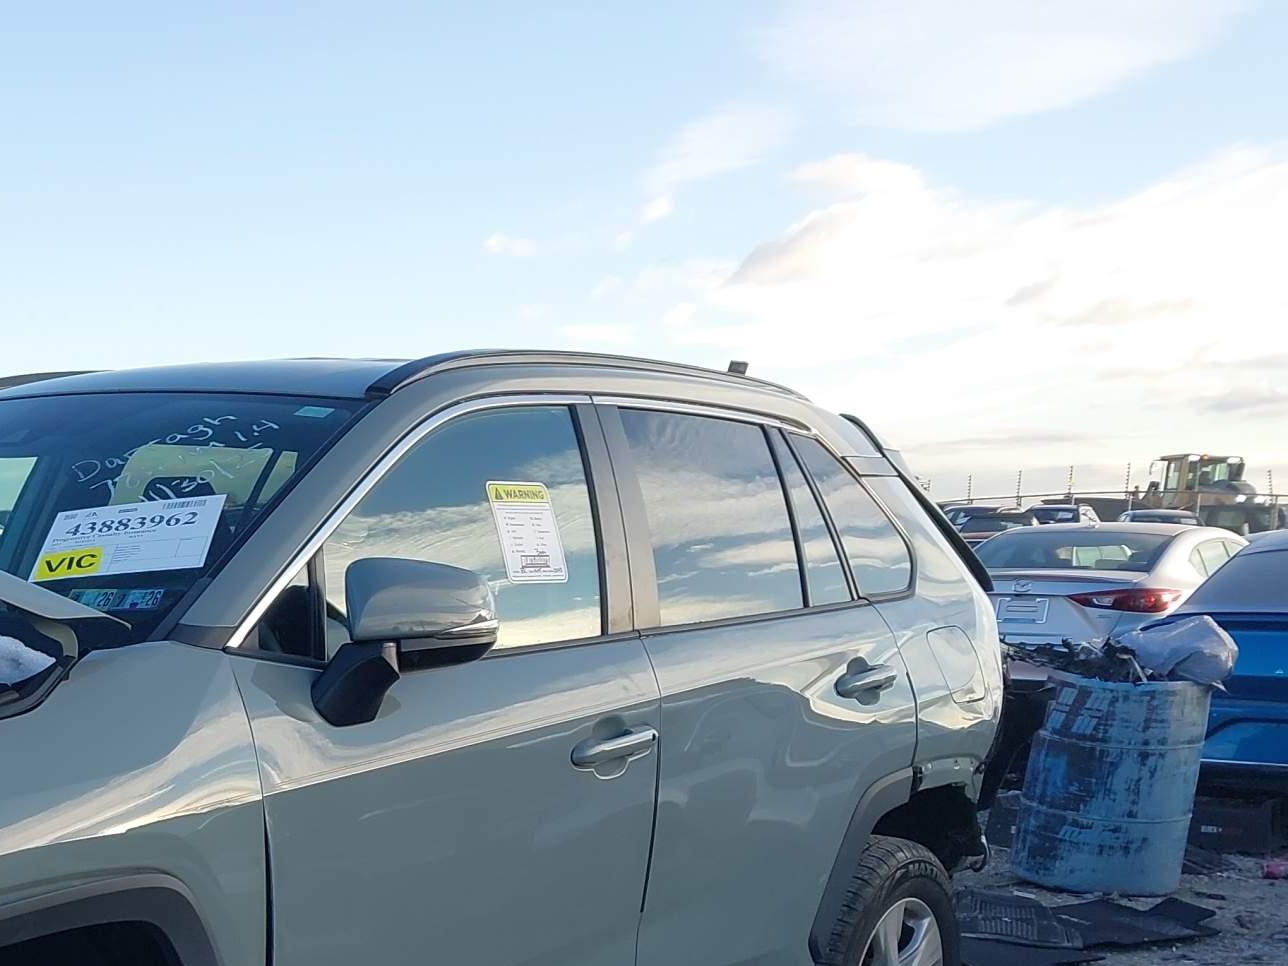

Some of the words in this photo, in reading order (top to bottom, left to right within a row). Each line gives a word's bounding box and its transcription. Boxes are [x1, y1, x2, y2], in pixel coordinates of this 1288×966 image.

[503, 487, 545, 500] WARNING
[65, 511, 199, 537] 43883962
[45, 553, 98, 573] VIC
[97, 591, 114, 607] 26
[145, 590, 162, 607] 26
